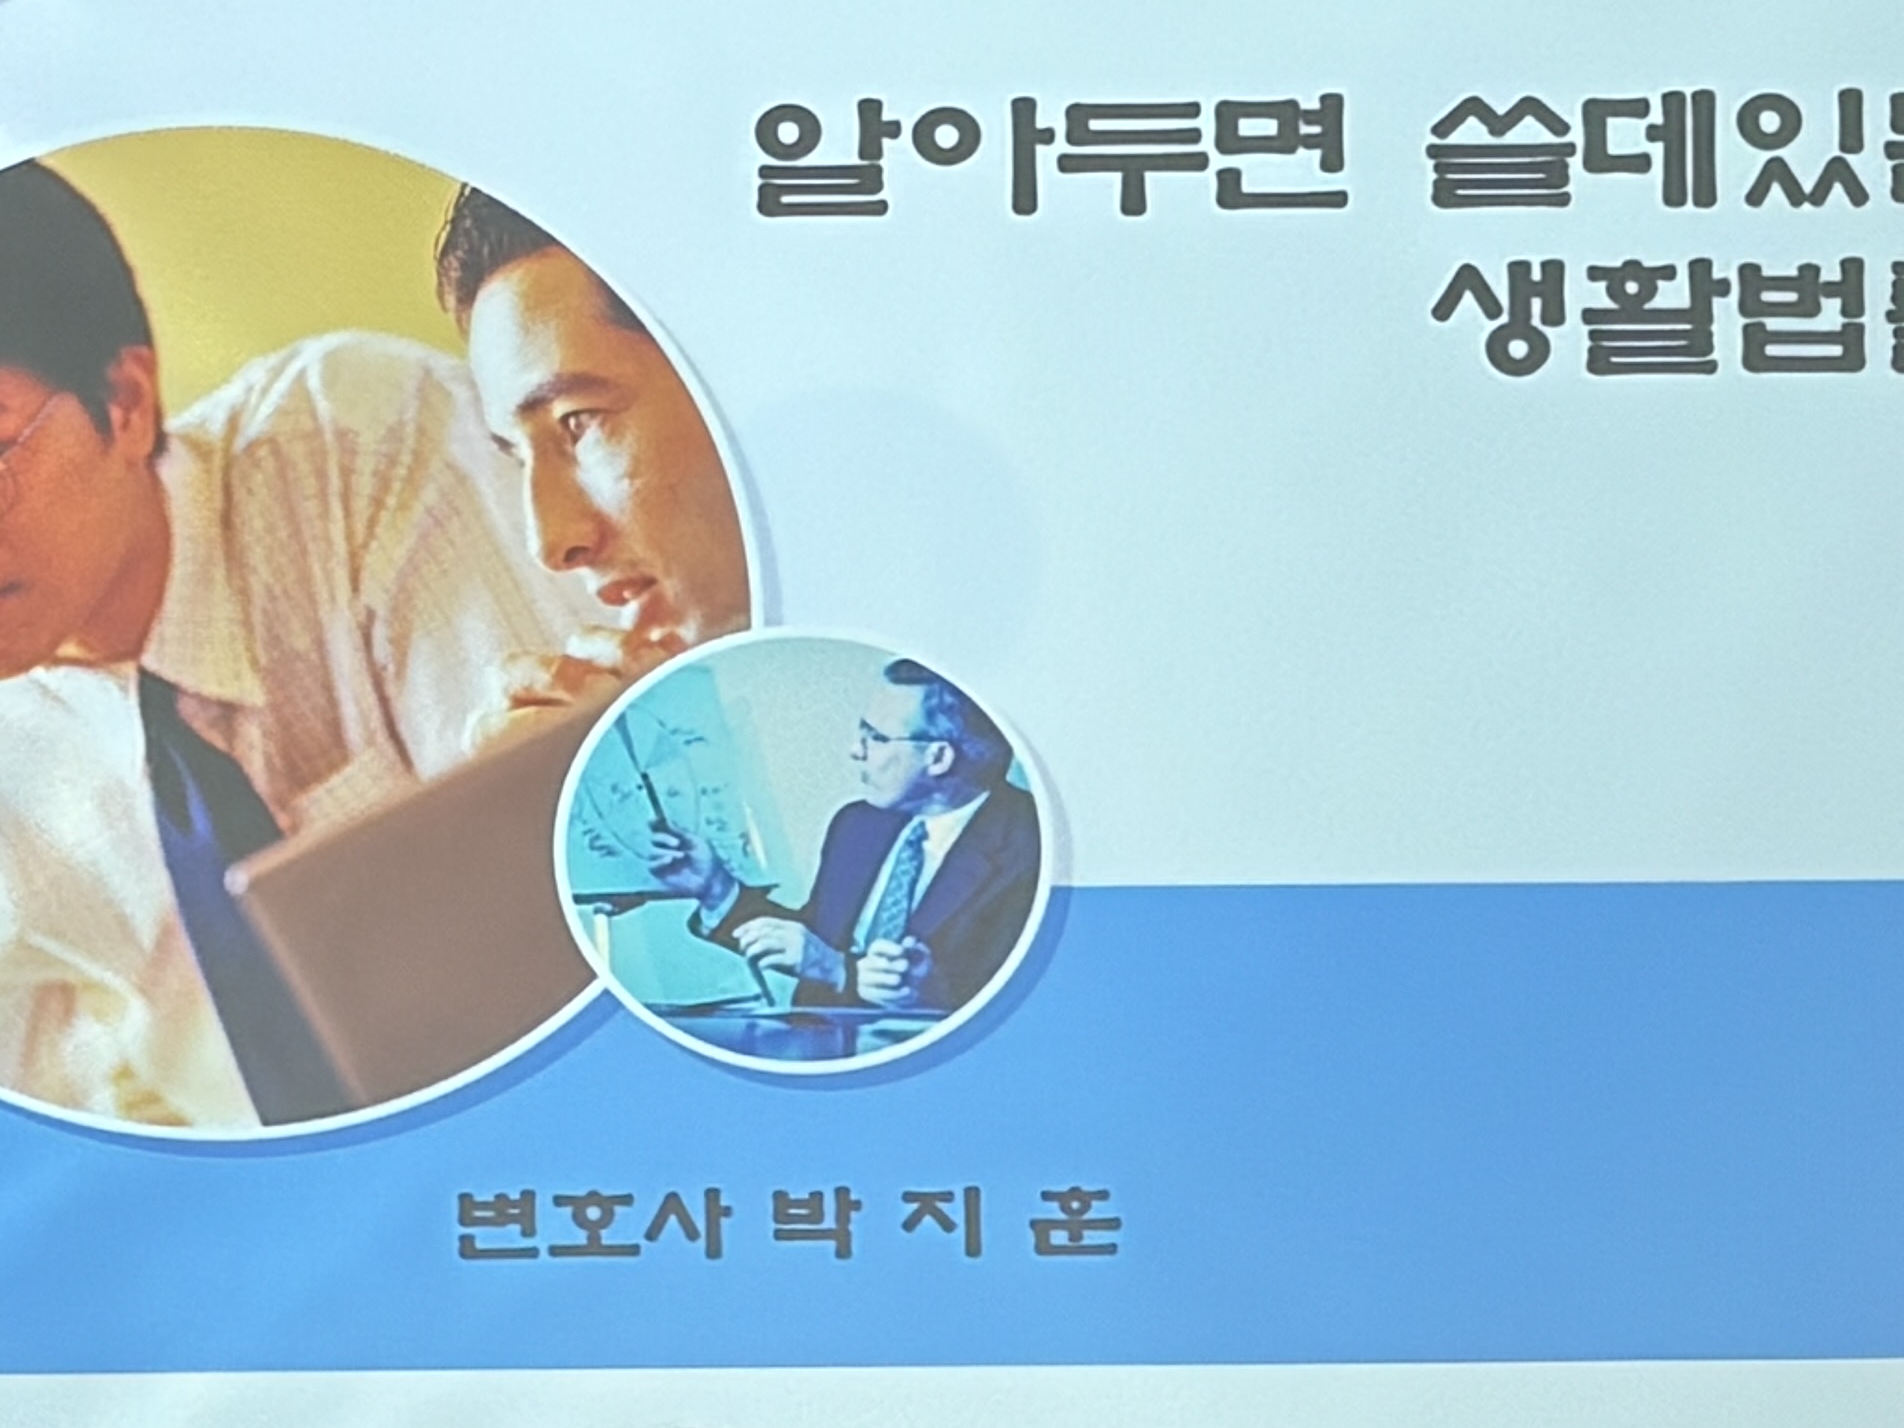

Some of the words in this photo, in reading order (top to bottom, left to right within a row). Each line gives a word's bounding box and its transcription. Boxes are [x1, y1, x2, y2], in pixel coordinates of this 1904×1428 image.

[753, 91, 1350, 218] 알아두면
[1424, 86, 1904, 210] 쓸데있
[1430, 255, 1904, 378] 생활법
[457, 1186, 733, 1260] 변호사
